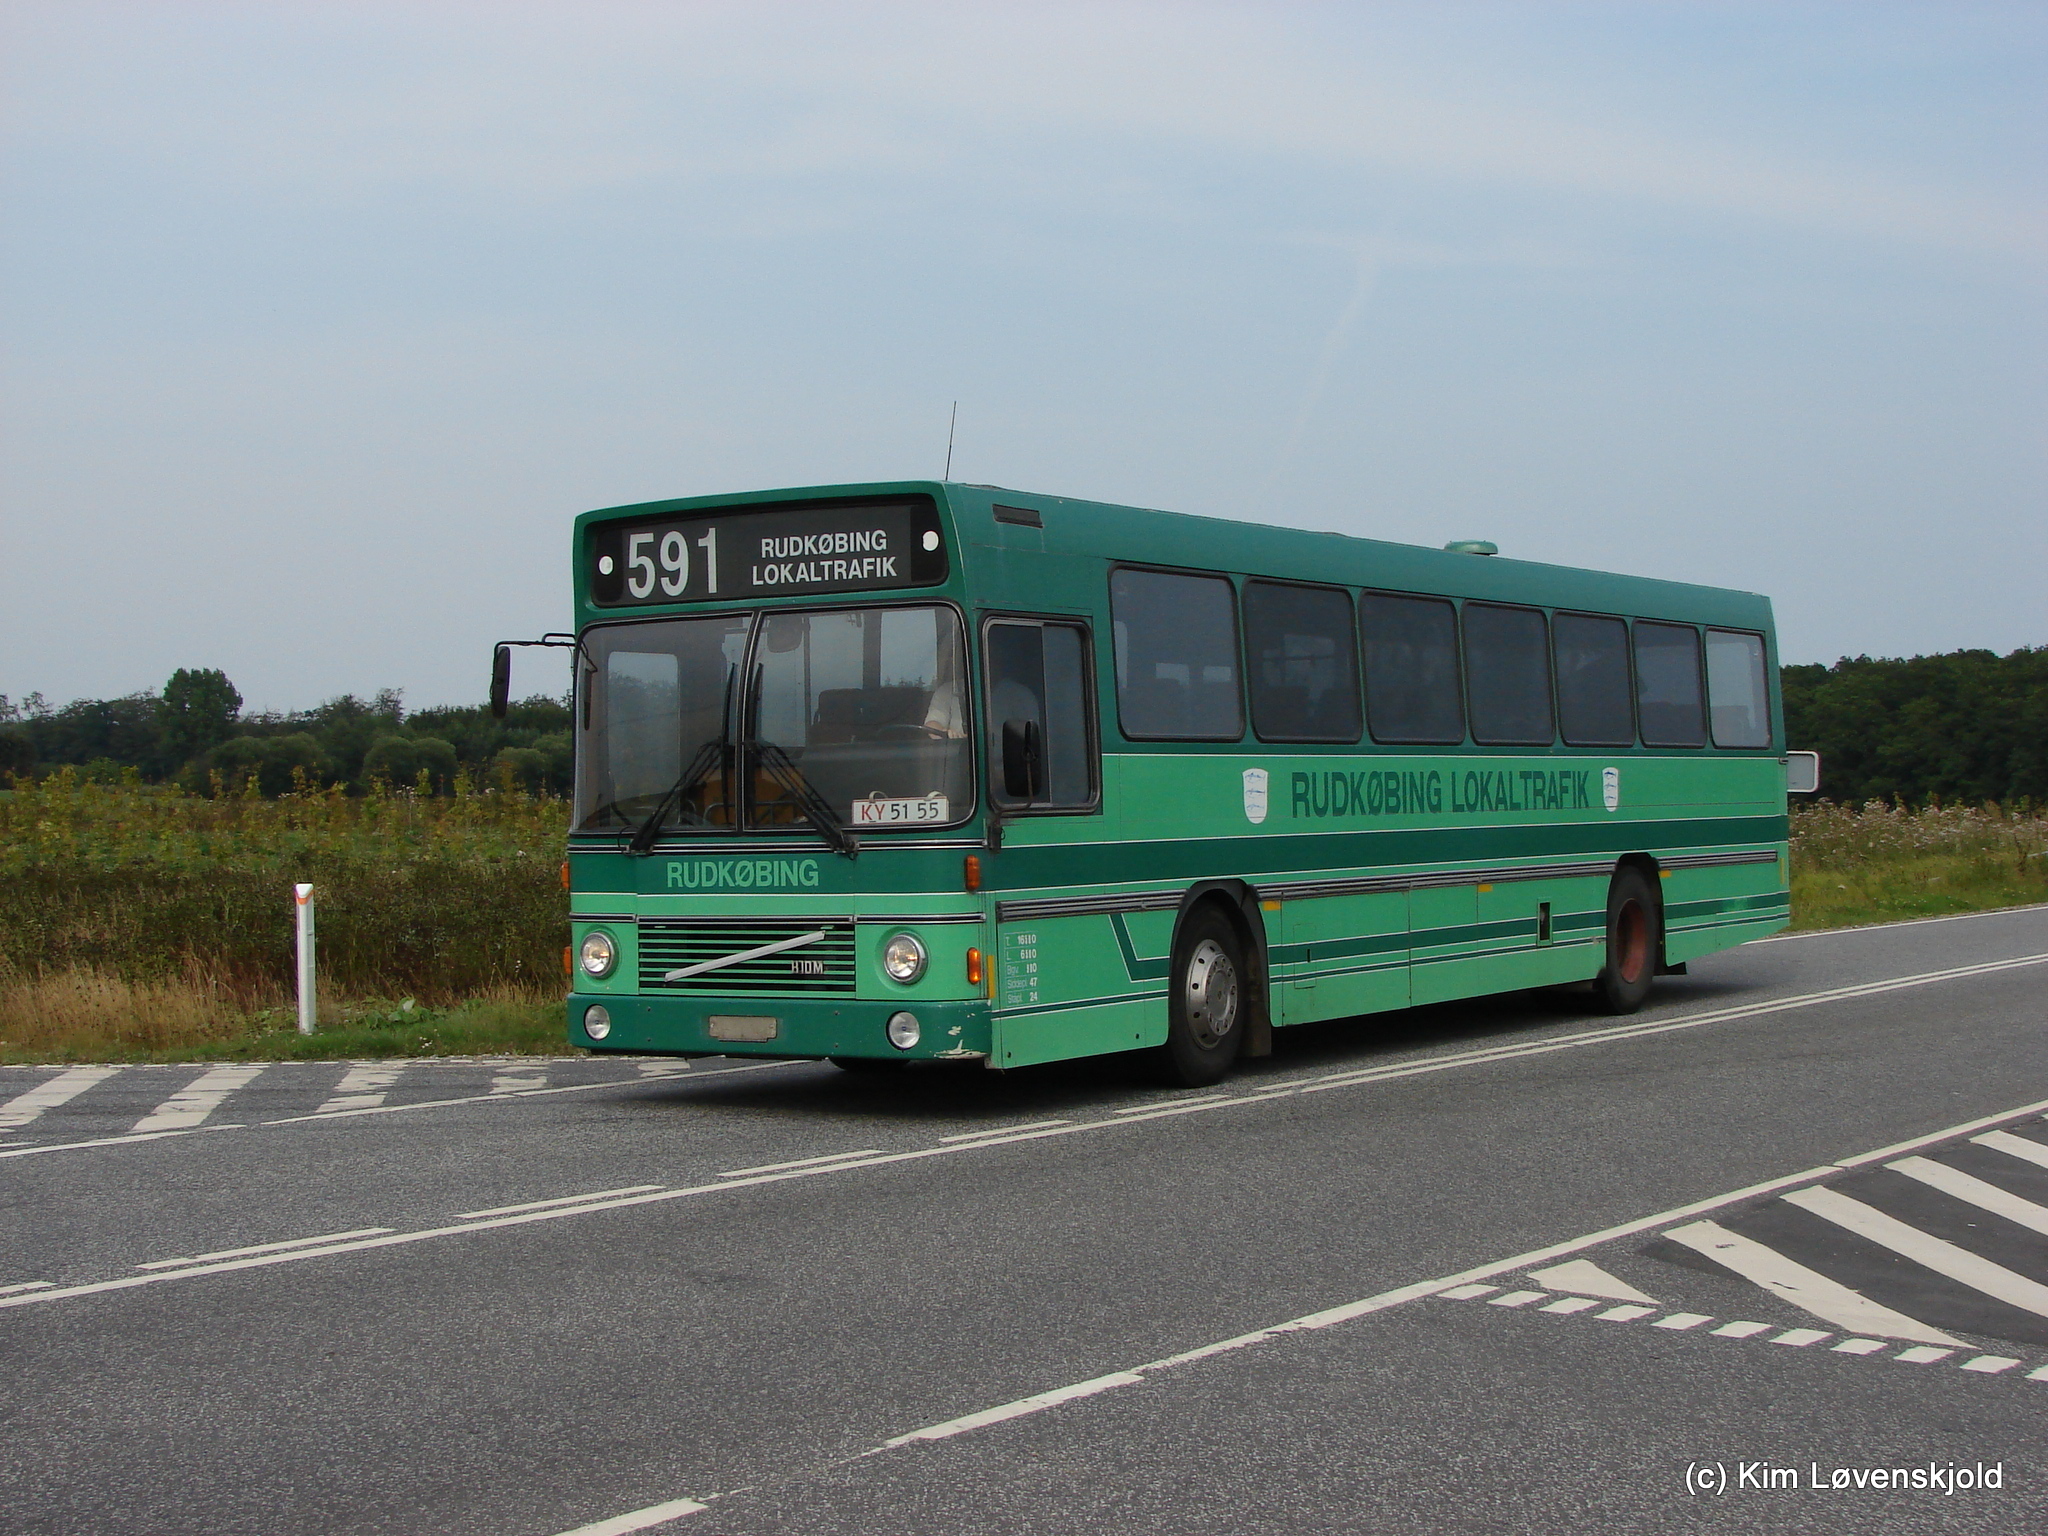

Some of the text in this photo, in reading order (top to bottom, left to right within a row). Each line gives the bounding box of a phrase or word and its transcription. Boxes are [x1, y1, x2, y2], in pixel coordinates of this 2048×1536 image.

[761, 529, 888, 559] RUDKØBING
[627, 527, 717, 599] 591
[752, 556, 898, 586] LOKALTRAFIK
[1291, 770, 1590, 818] RUDKØBING LOKALTRAFIK
[861, 802, 939, 821] KY 51 55
[667, 859, 820, 889] RUDKØBING
